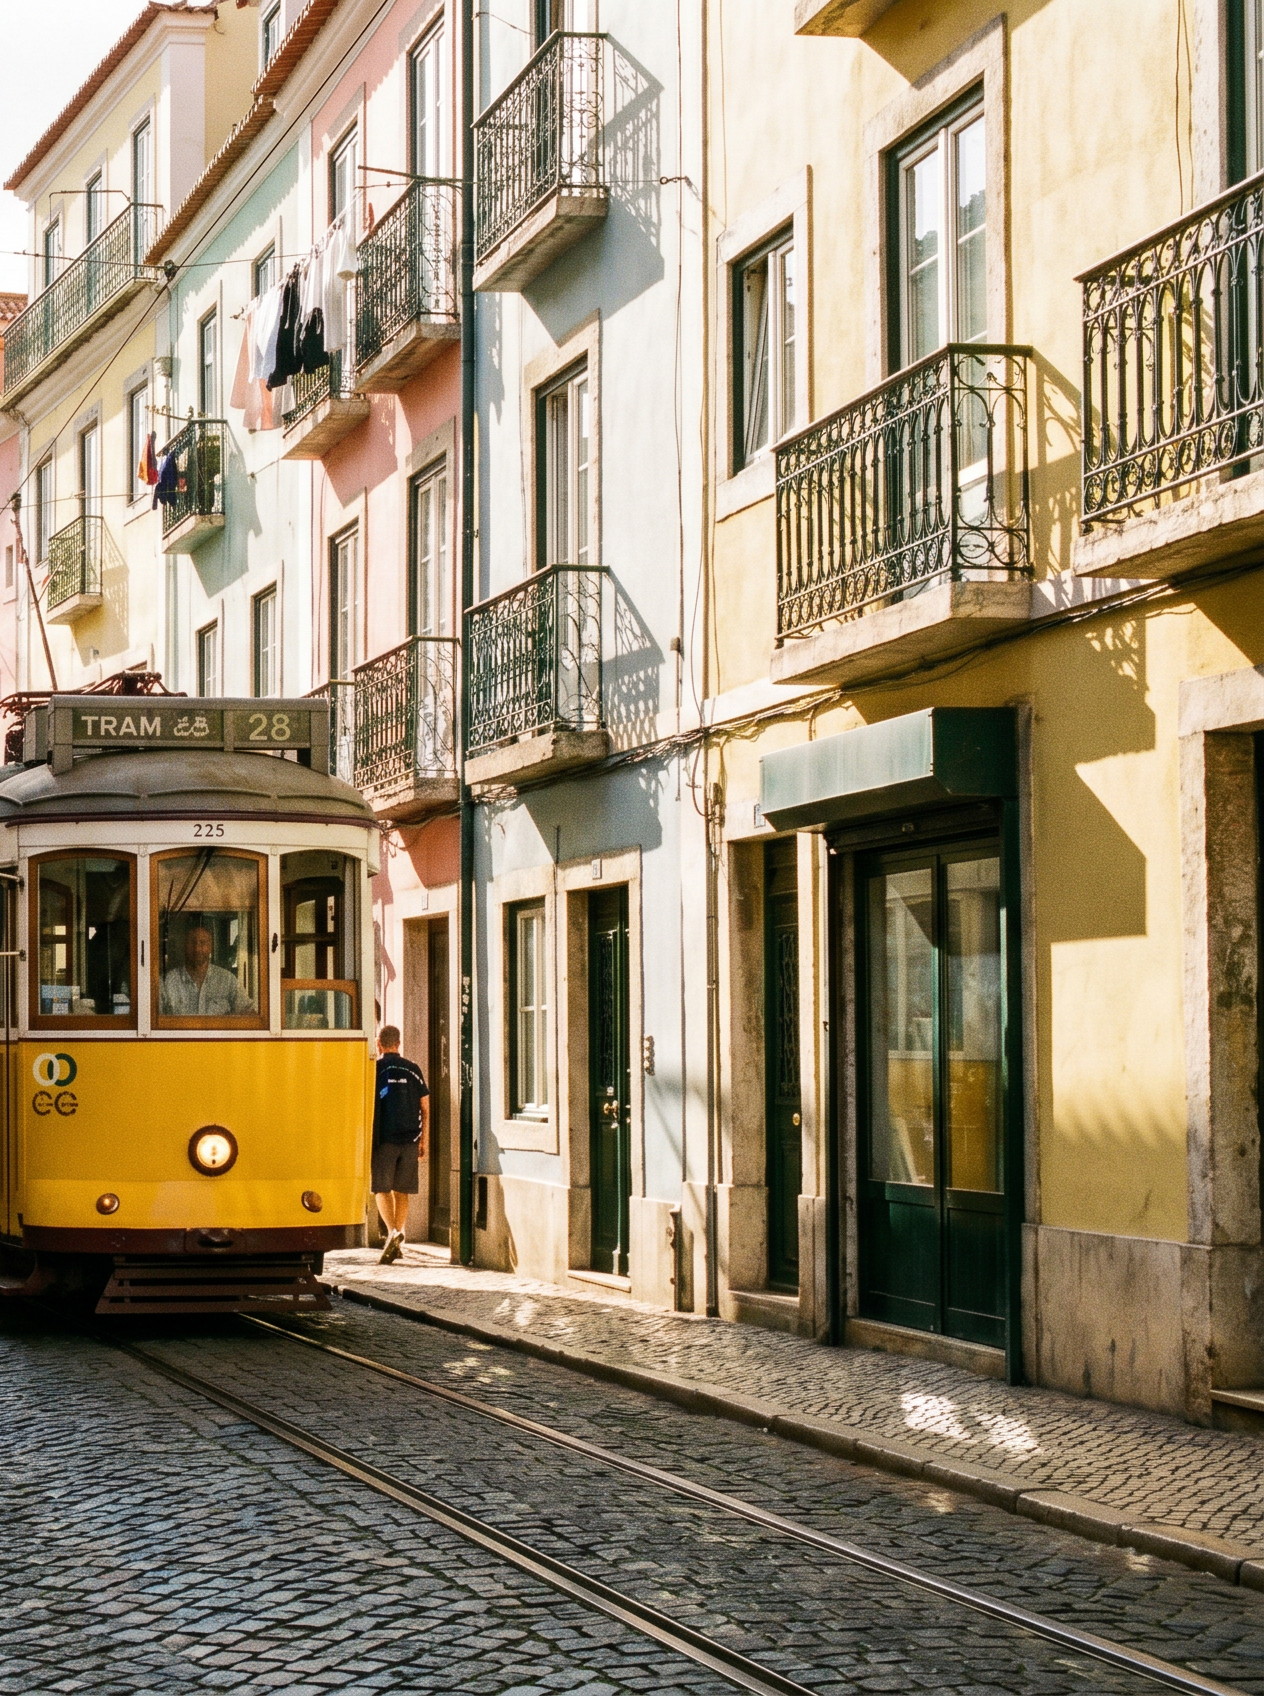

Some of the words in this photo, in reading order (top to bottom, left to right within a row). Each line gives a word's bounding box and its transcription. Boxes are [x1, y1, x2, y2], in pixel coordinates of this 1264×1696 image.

[81, 715, 161, 737] TRAM
[248, 713, 291, 741] 28
[193, 823, 225, 838] 225
